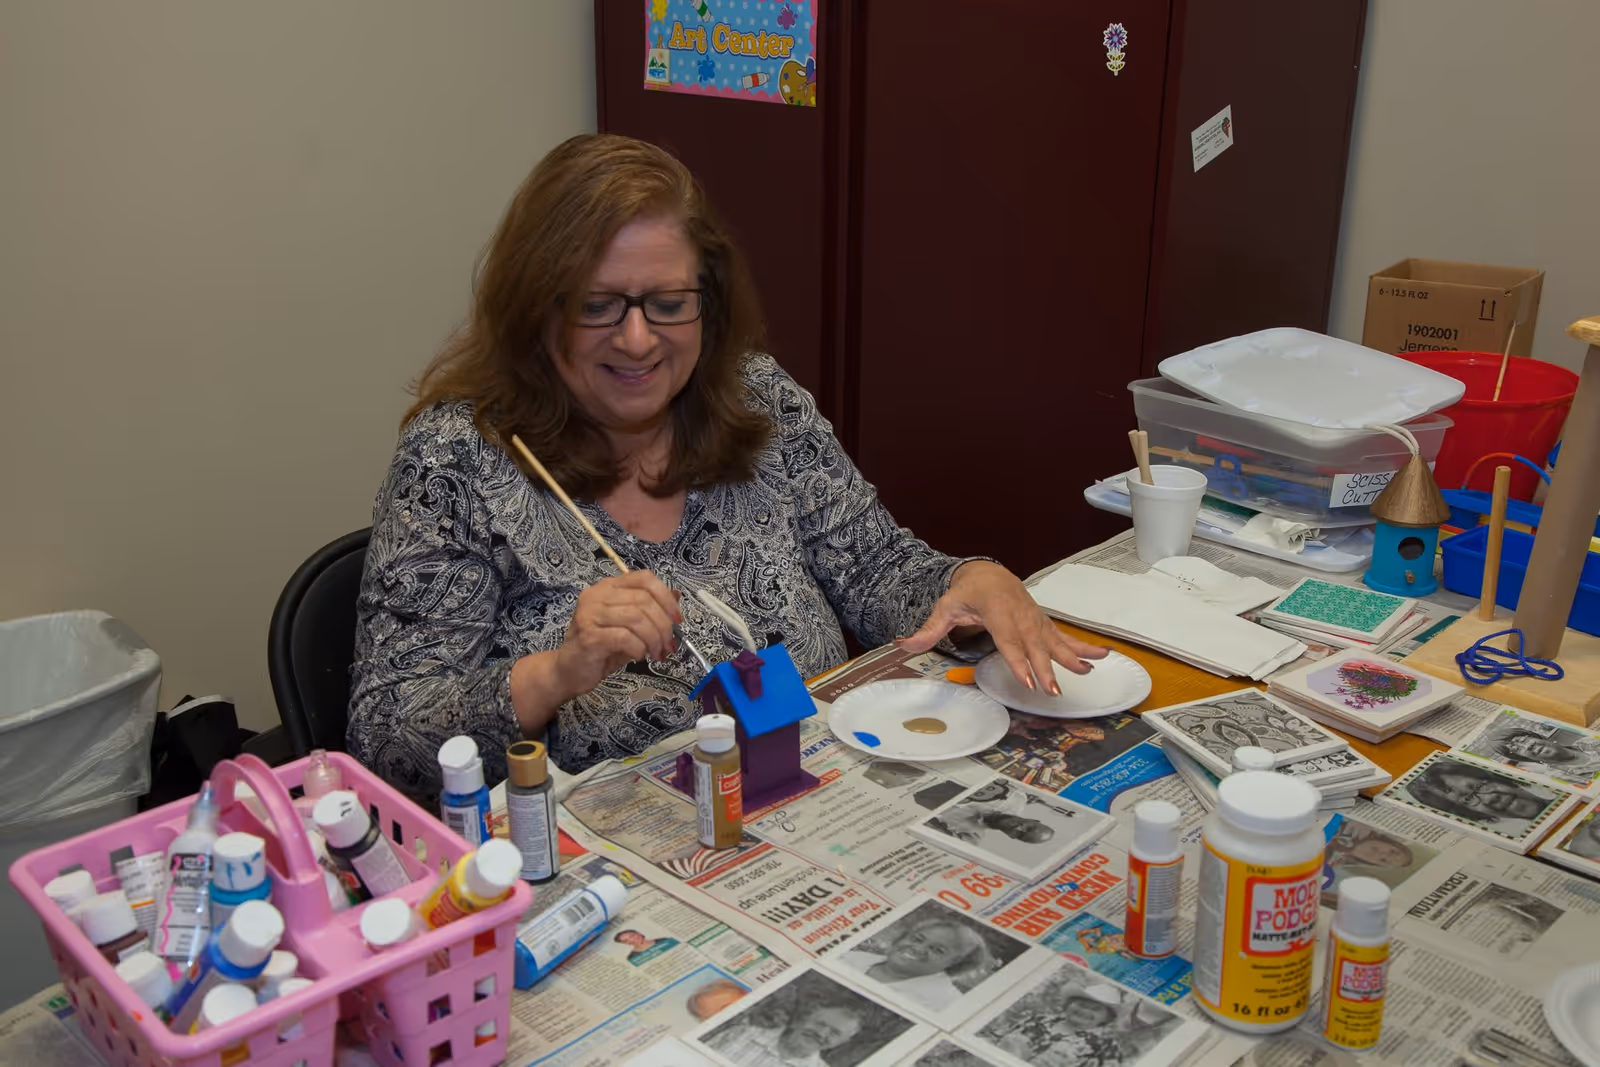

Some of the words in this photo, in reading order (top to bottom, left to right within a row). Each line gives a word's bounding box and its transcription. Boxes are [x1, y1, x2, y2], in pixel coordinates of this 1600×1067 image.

[668, 22, 707, 54] Art
[711, 22, 795, 59] Center
[1378, 287, 1385, 296] 6
[1408, 290, 1416, 299] FL
[1417, 291, 1430, 300] OZ
[1406, 324, 1459, 341] 1902001
[1346, 472, 1391, 489] SCISS
[823, 876, 845, 888] 1
[1055, 869, 1124, 911] NEED
[1273, 879, 1318, 909] MOD
[760, 884, 833, 924] DAY!!!
[848, 899, 881, 918] Your
[1012, 906, 1065, 938] AIR
[1232, 1002, 1252, 1016] 16
[1256, 1005, 1270, 1017] fl
[1273, 1005, 1292, 1017] oz
